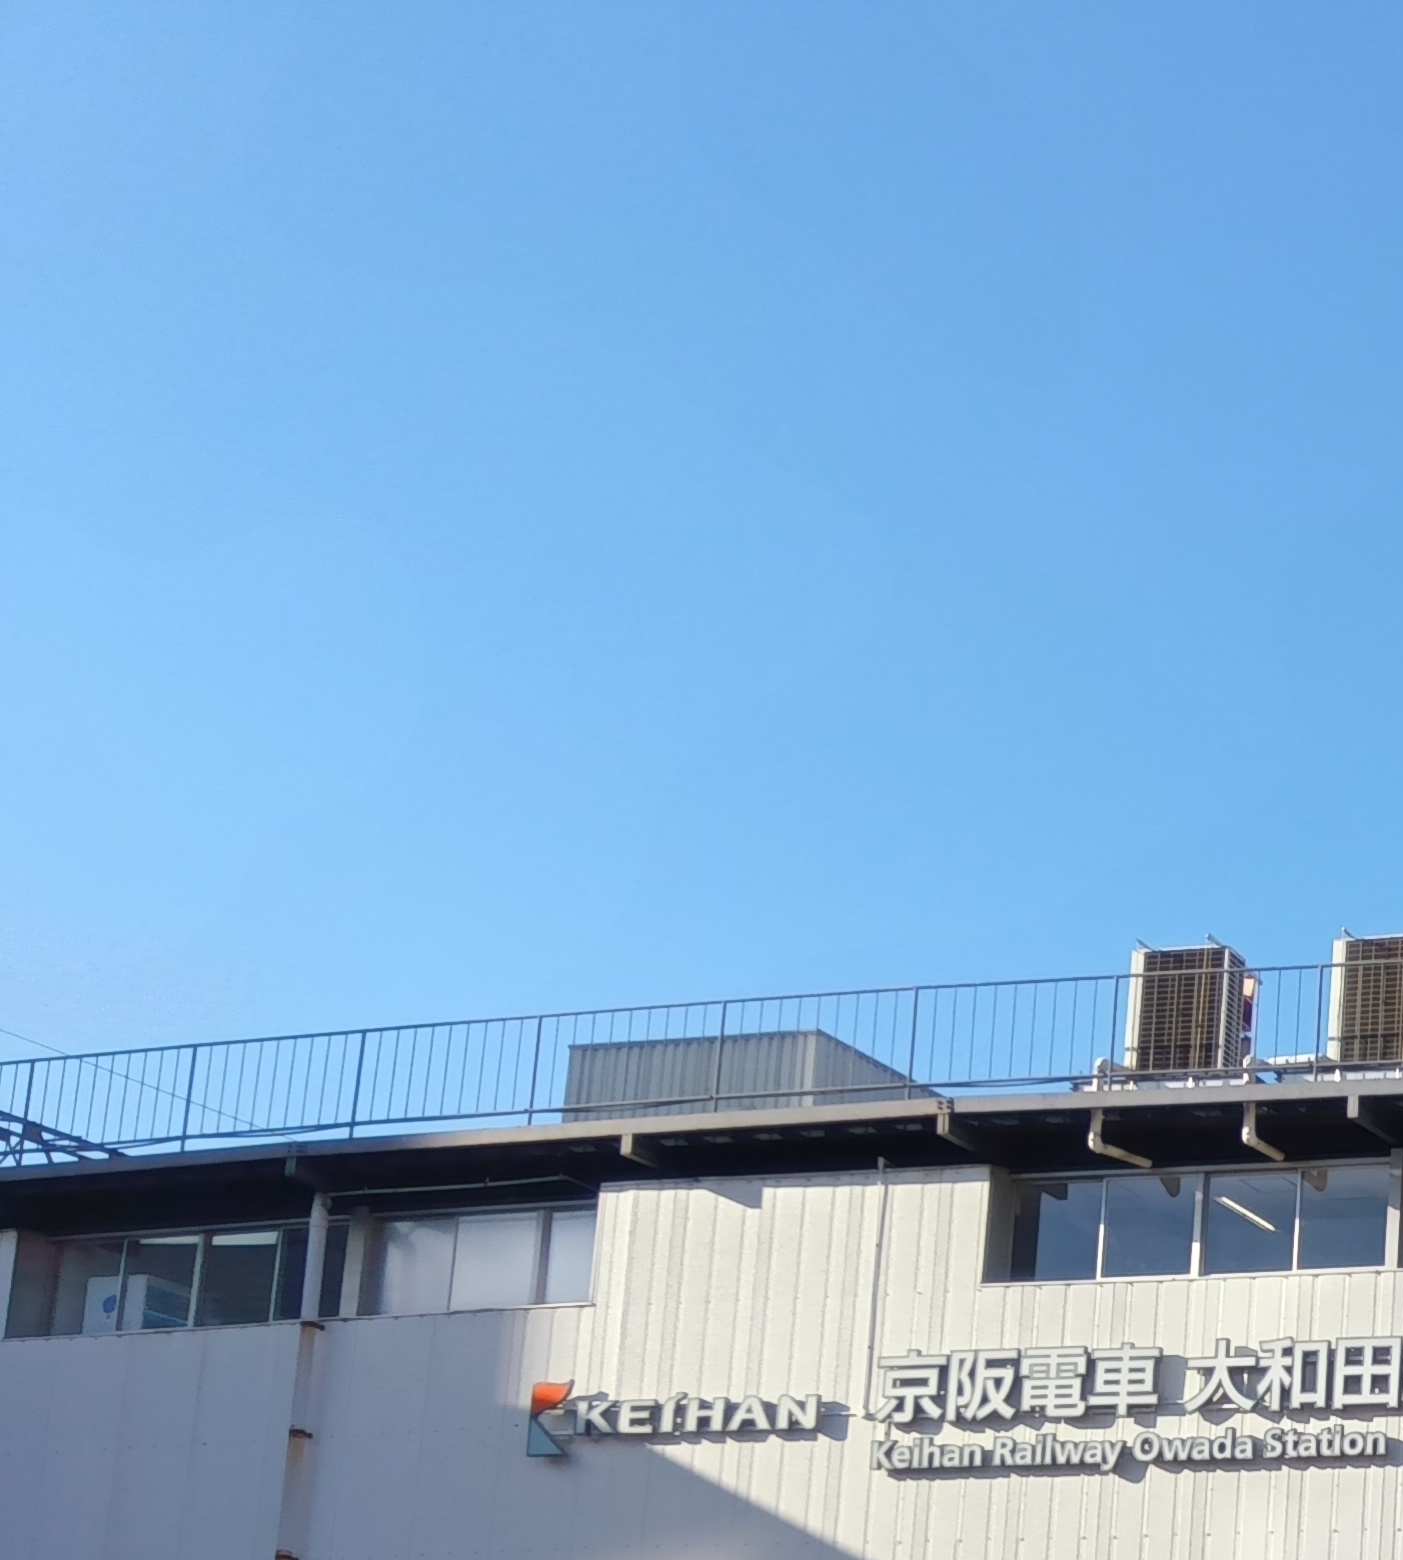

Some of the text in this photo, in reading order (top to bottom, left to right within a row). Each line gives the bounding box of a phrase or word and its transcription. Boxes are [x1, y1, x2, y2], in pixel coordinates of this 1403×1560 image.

[874, 1341, 1162, 1423] 京阪電車
[575, 1391, 822, 1436] KEIHAN
[871, 1424, 1388, 1471] Keihan Railway Owada Station
